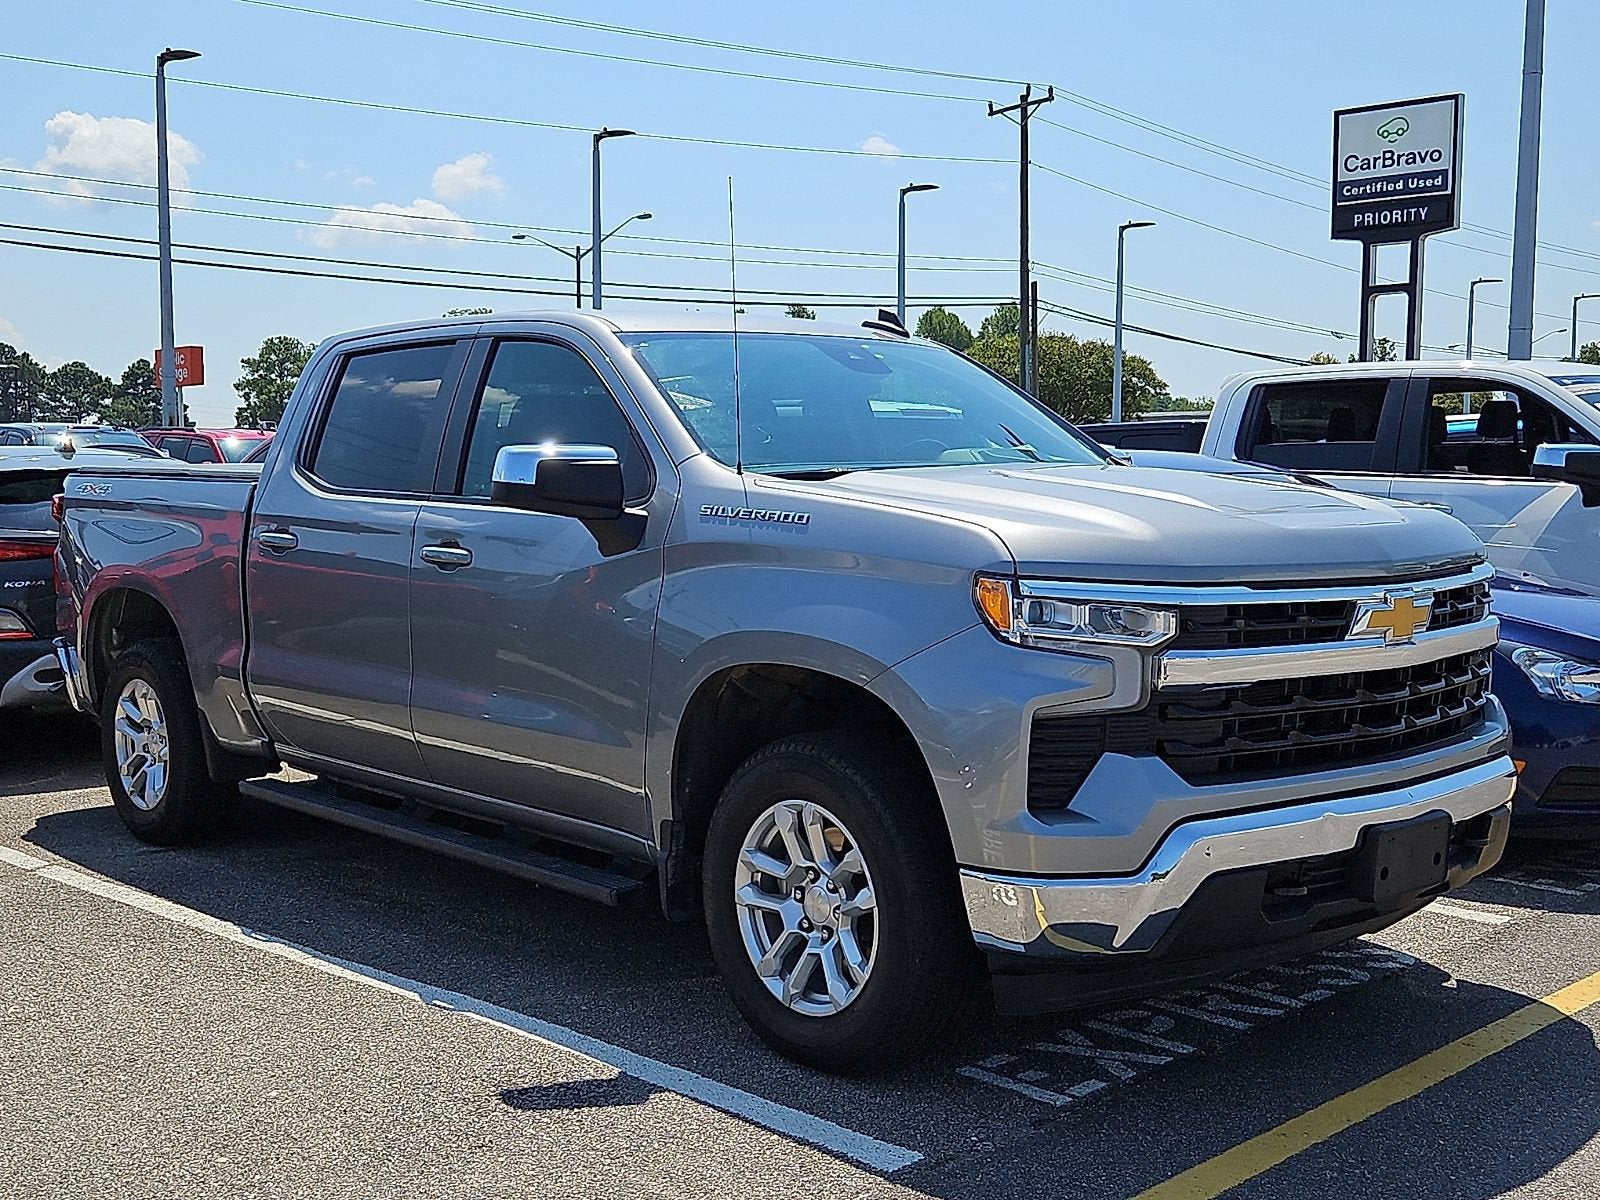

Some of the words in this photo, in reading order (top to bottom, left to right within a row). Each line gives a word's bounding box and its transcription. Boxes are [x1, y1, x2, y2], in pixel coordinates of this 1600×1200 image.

[1344, 149, 1443, 173] CarBravo
[1342, 179, 1404, 197] Certified
[1408, 175, 1443, 189] Used
[1353, 206, 1429, 228] PRIORITY
[699, 503, 811, 525] SILVERADO
[4, 580, 46, 588] KONA
